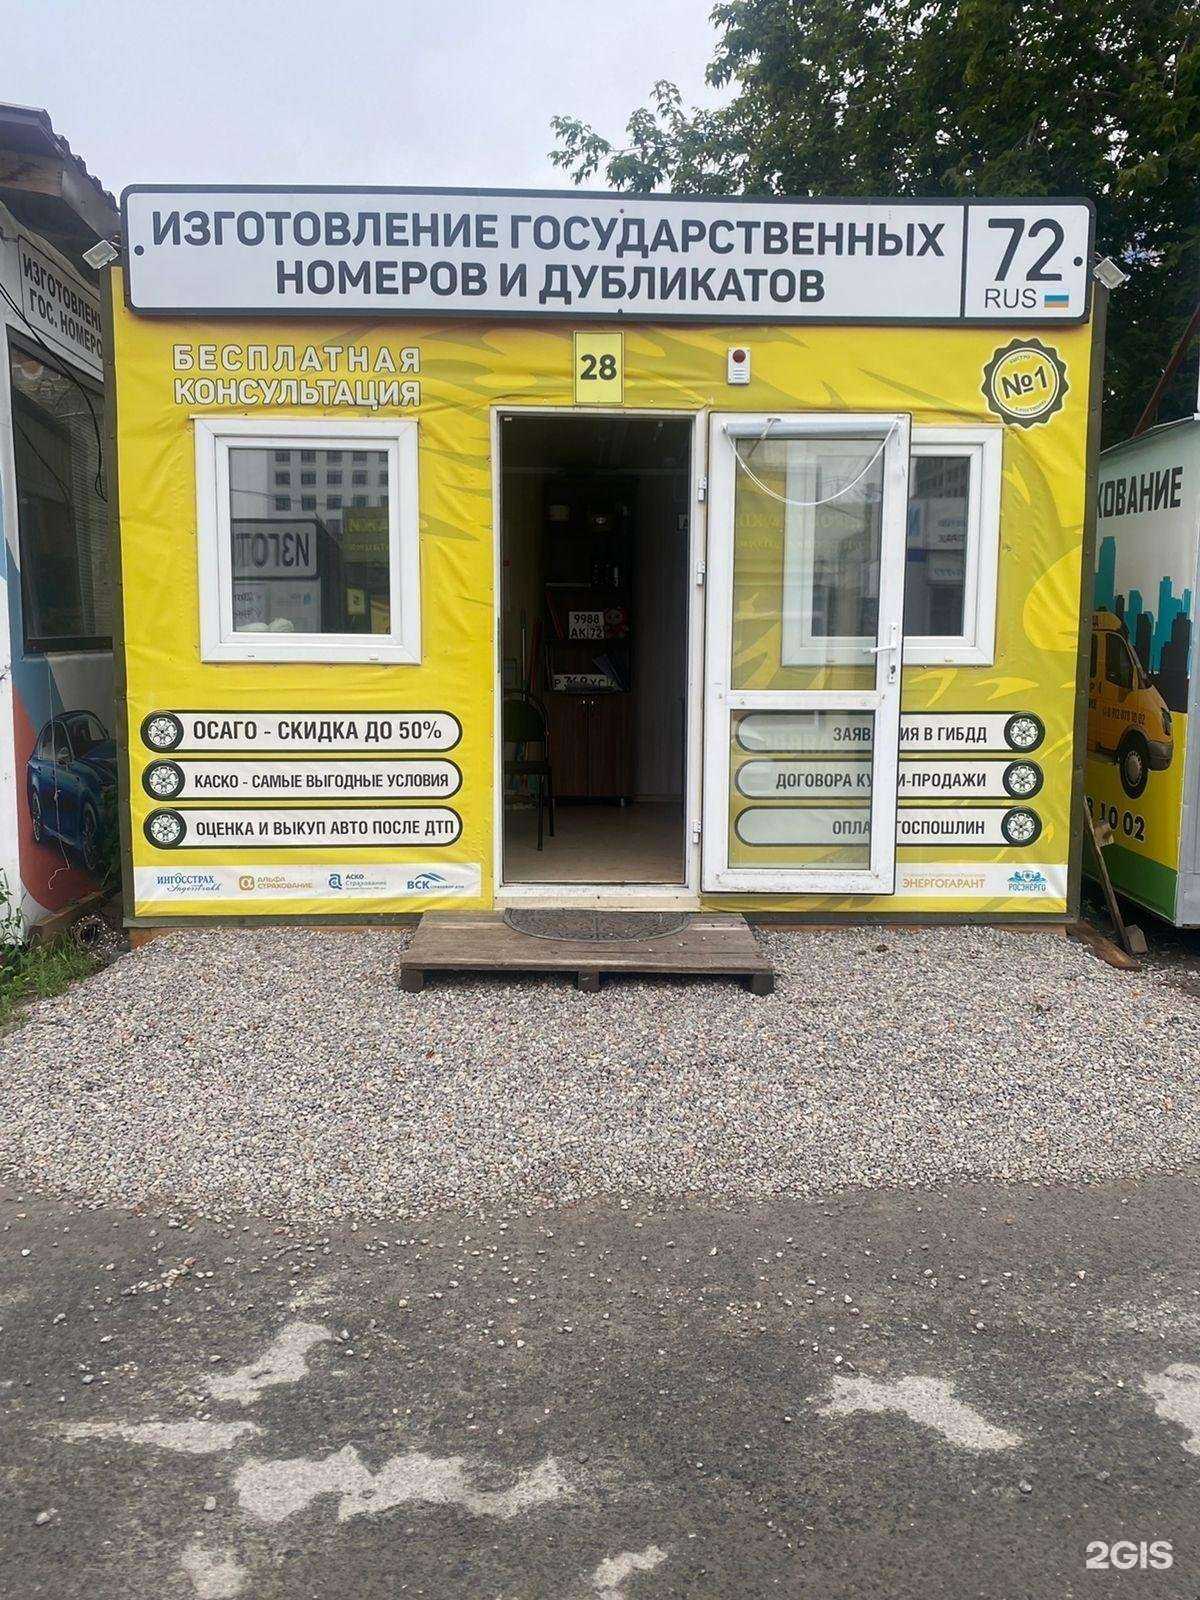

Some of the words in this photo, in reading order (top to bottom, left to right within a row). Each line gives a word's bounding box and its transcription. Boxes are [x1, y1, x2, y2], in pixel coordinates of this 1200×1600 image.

[152, 210, 498, 249] ИЗГОТОВЛЕНИЕ
[511, 214, 945, 260] ГОСУДАРСТВЕННЫХ
[988, 217, 1066, 282] 72
[276, 260, 488, 297] НОМЕРОВ
[500, 263, 526, 298] И
[538, 265, 826, 305] ДУБЛИКАТОВ
[29, 288, 58, 328] ГОС.
[984, 288, 1037, 309] RUS
[172, 343, 422, 373] БЕСПЛАТНАЯ
[580, 353, 617, 381] 28
[173, 377, 422, 411] КОНСУЛЬТАЦИЯ
[193, 720, 257, 741] ОСАГО
[277, 720, 359, 744] СКИДКА
[364, 720, 393, 744] ДО
[399, 720, 442, 741] 50%
[924, 727, 933, 741] В
[937, 727, 988, 743] ГИБДД
[194, 774, 239, 789] КАСКО
[251, 774, 302, 789] САМЫЕ
[305, 773, 383, 791] ВЫГОДНЫЕ
[388, 773, 449, 789] УСЛОВИЯ
[776, 773, 853, 790] ДОГОВОРА
[195, 821, 255, 839] ОЦЕНКА
[258, 821, 269, 836] И
[273, 821, 325, 836] ВЫКУП
[330, 820, 369, 835] АВТО
[373, 820, 421, 835] ПОСЛЕ
[424, 820, 454, 837] ДТП
[1123, 810, 1146, 844] 02
[157, 873, 215, 884] ИНГОССТРАХ
[257, 882, 313, 890] СТРАХОВАНИЕ
[406, 880, 430, 890] ВСК
[902, 878, 986, 889] ЭНЕРГОГАРАНТ
[1008, 883, 1047, 892] РОСЭНЕРГО
